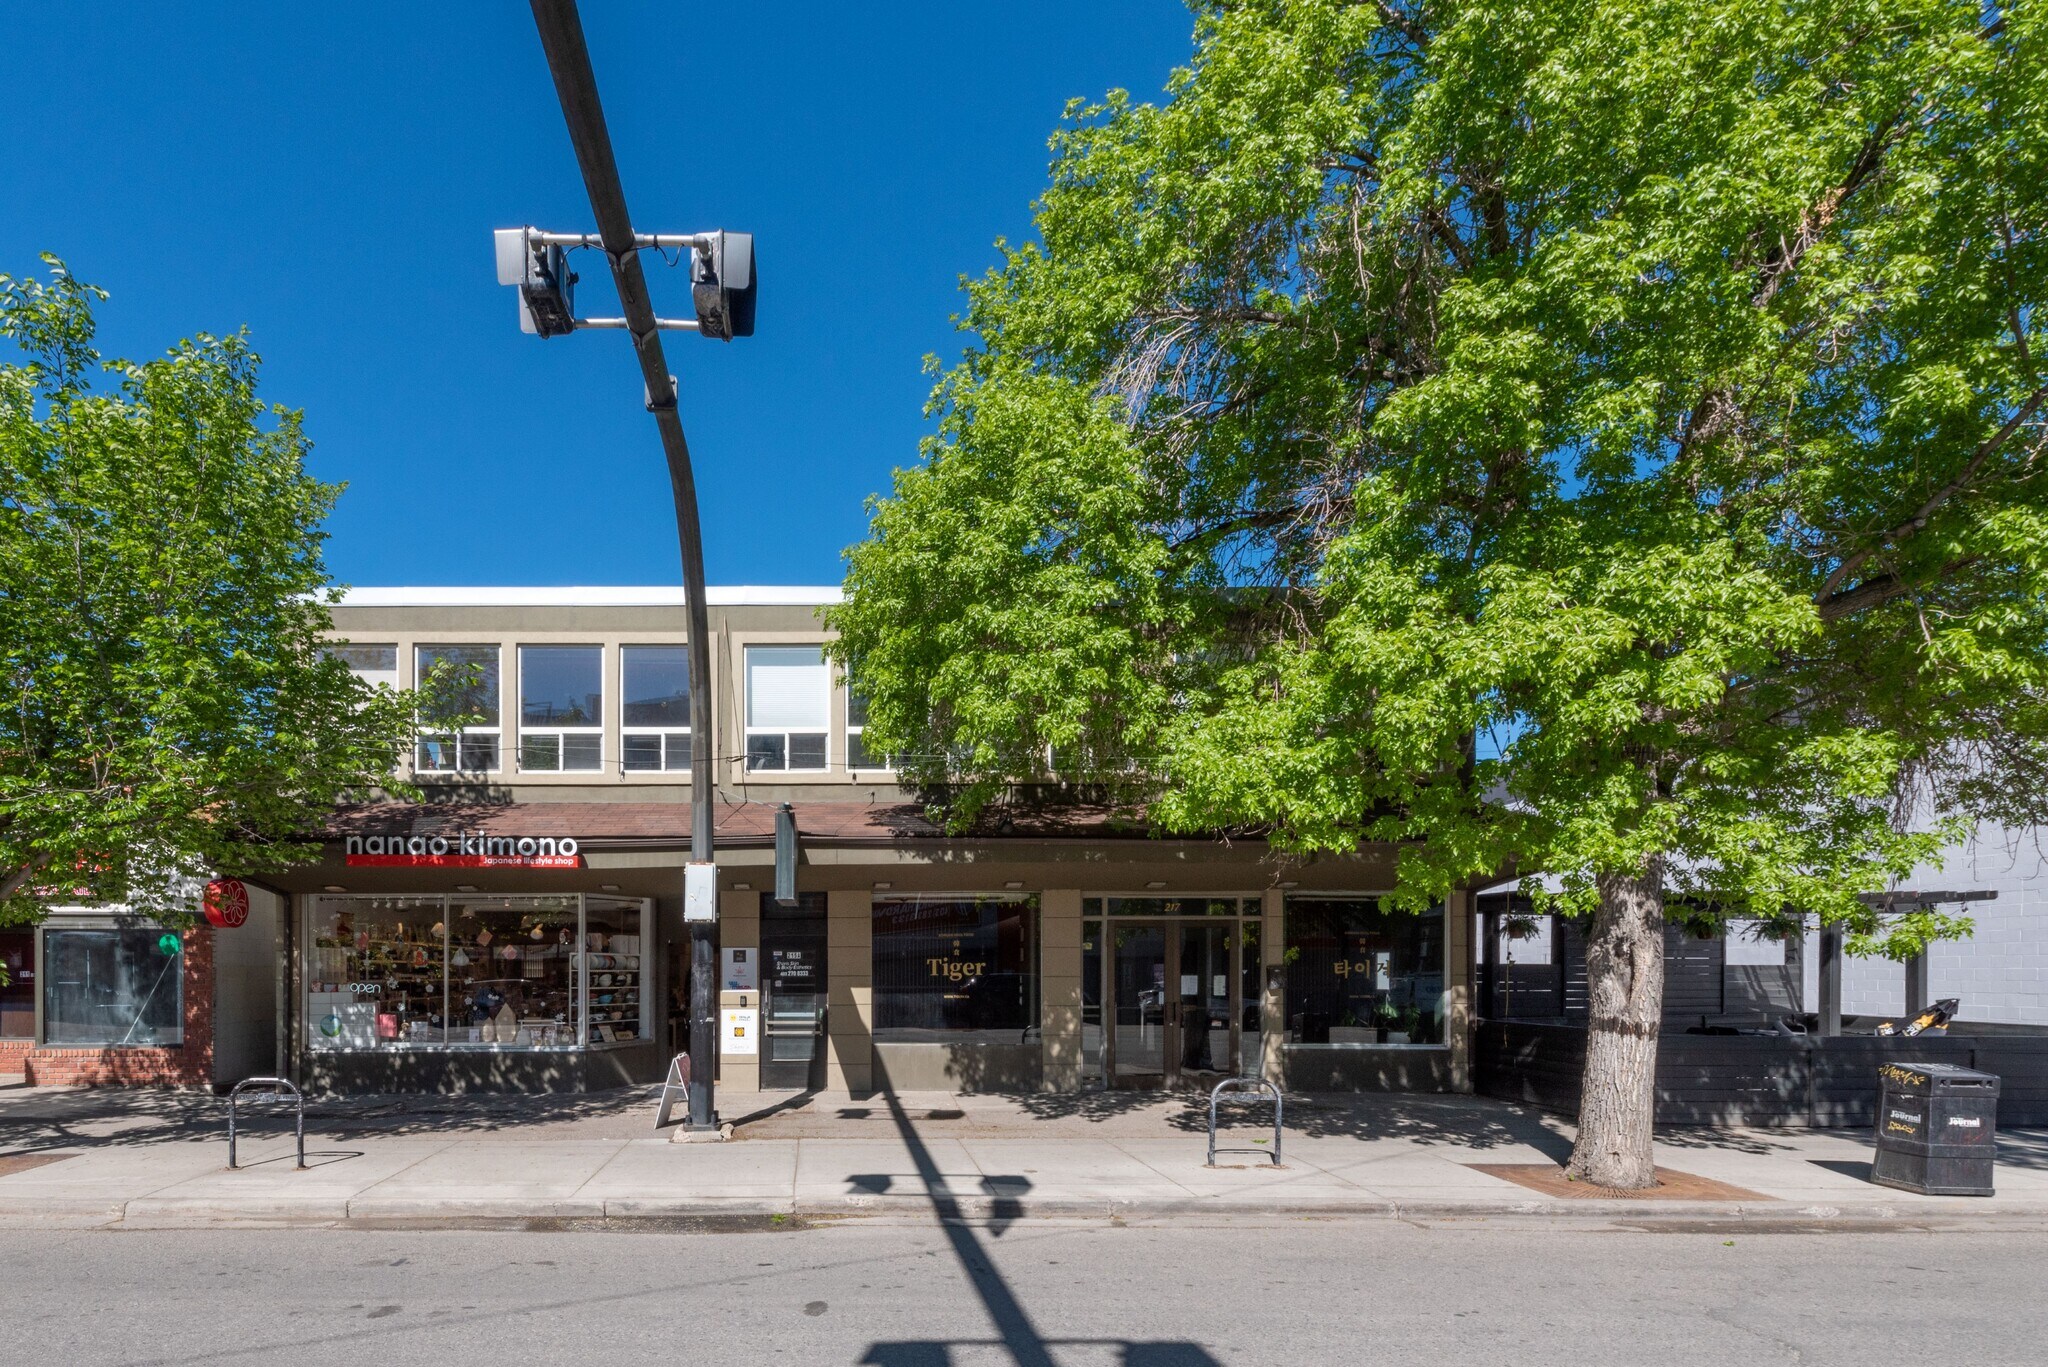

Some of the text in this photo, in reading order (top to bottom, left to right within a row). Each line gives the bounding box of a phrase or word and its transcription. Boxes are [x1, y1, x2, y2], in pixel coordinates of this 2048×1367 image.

[346, 830, 578, 857] nanao kimono
[483, 857, 574, 866] Japanese lifestyle shop
[1164, 902, 1181, 912] 217
[926, 957, 987, 981] Tiger
[350, 983, 381, 994] open
[1890, 1110, 1921, 1123] Journal
[1948, 1116, 1981, 1127] Journal
